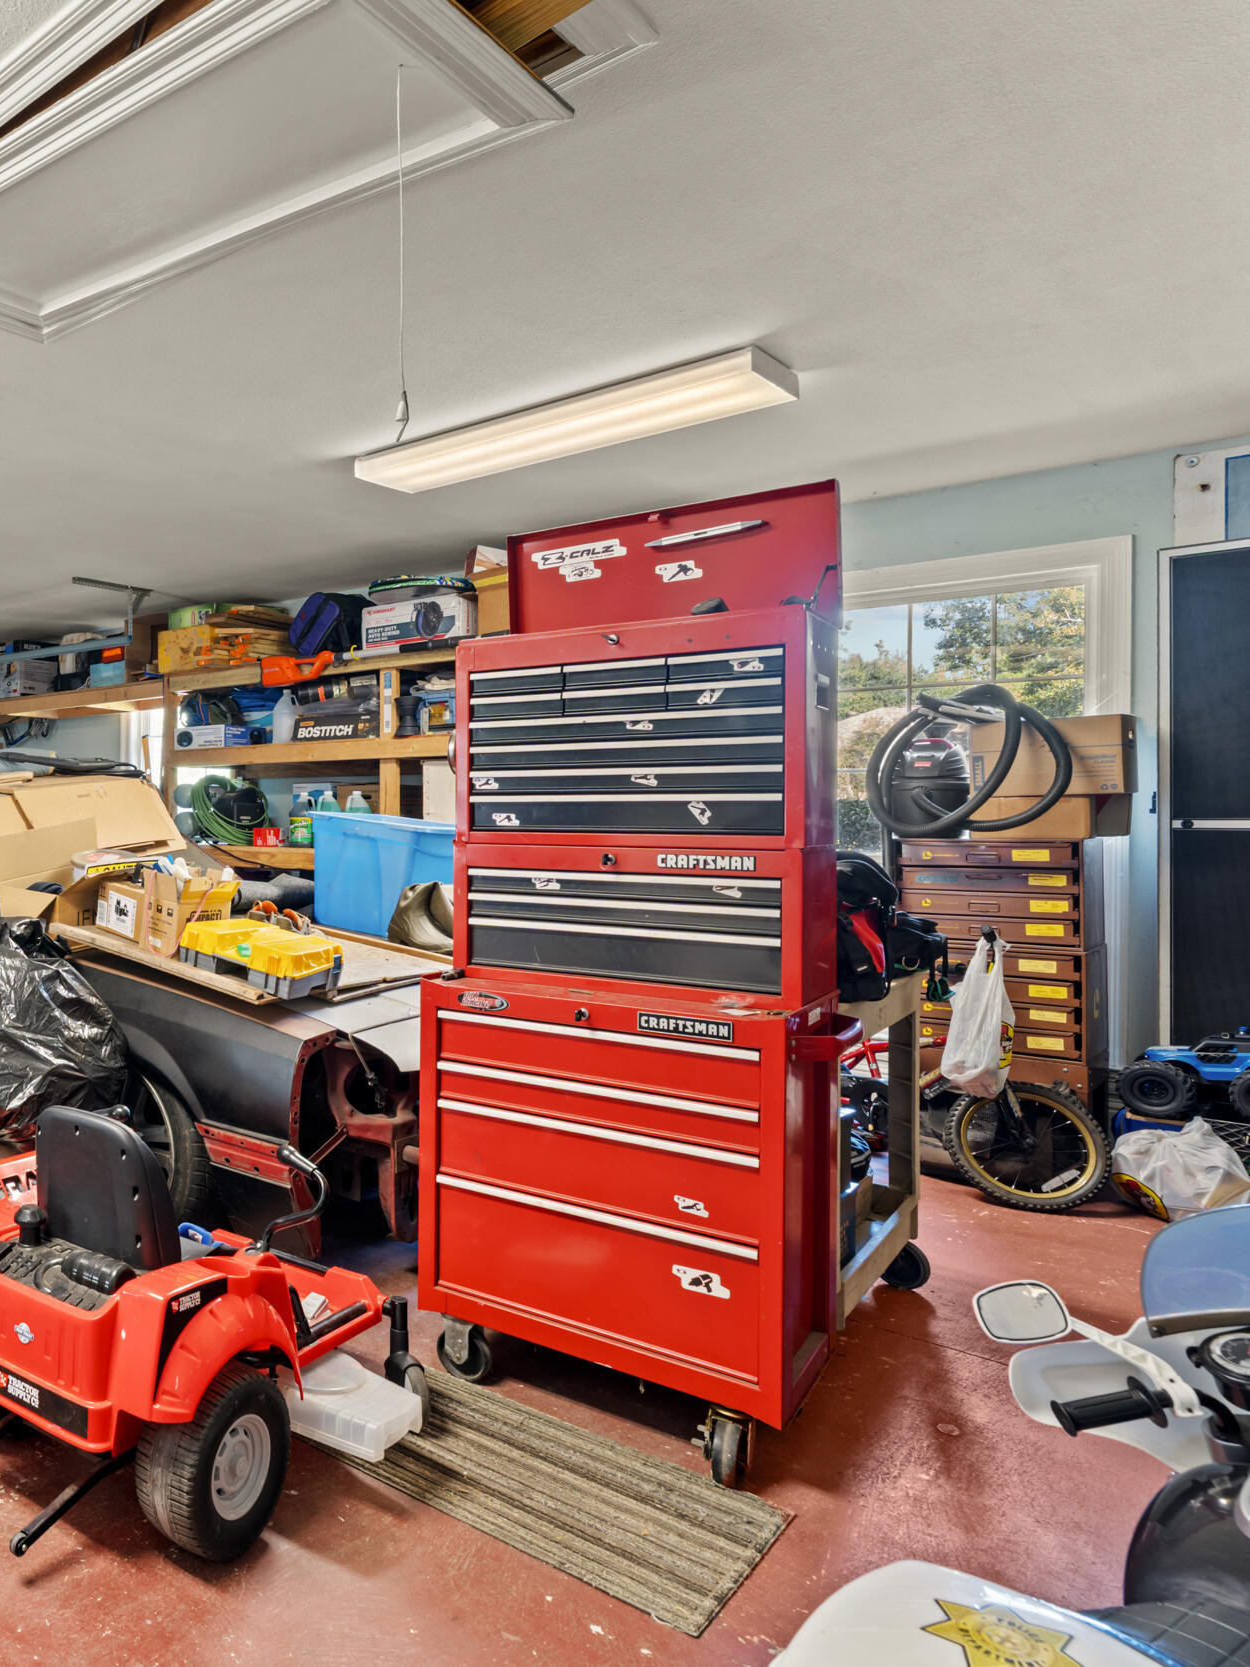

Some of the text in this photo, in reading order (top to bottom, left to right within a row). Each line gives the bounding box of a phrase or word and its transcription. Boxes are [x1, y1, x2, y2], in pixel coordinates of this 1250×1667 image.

[297, 725, 354, 739] BOSTITCH
[657, 854, 755, 871] CRAFTSMAN
[640, 1015, 729, 1037] CRAFTSMAN
[7, 1384, 31, 1404] SUPPLY
[8, 1375, 39, 1399] TRACTOR
